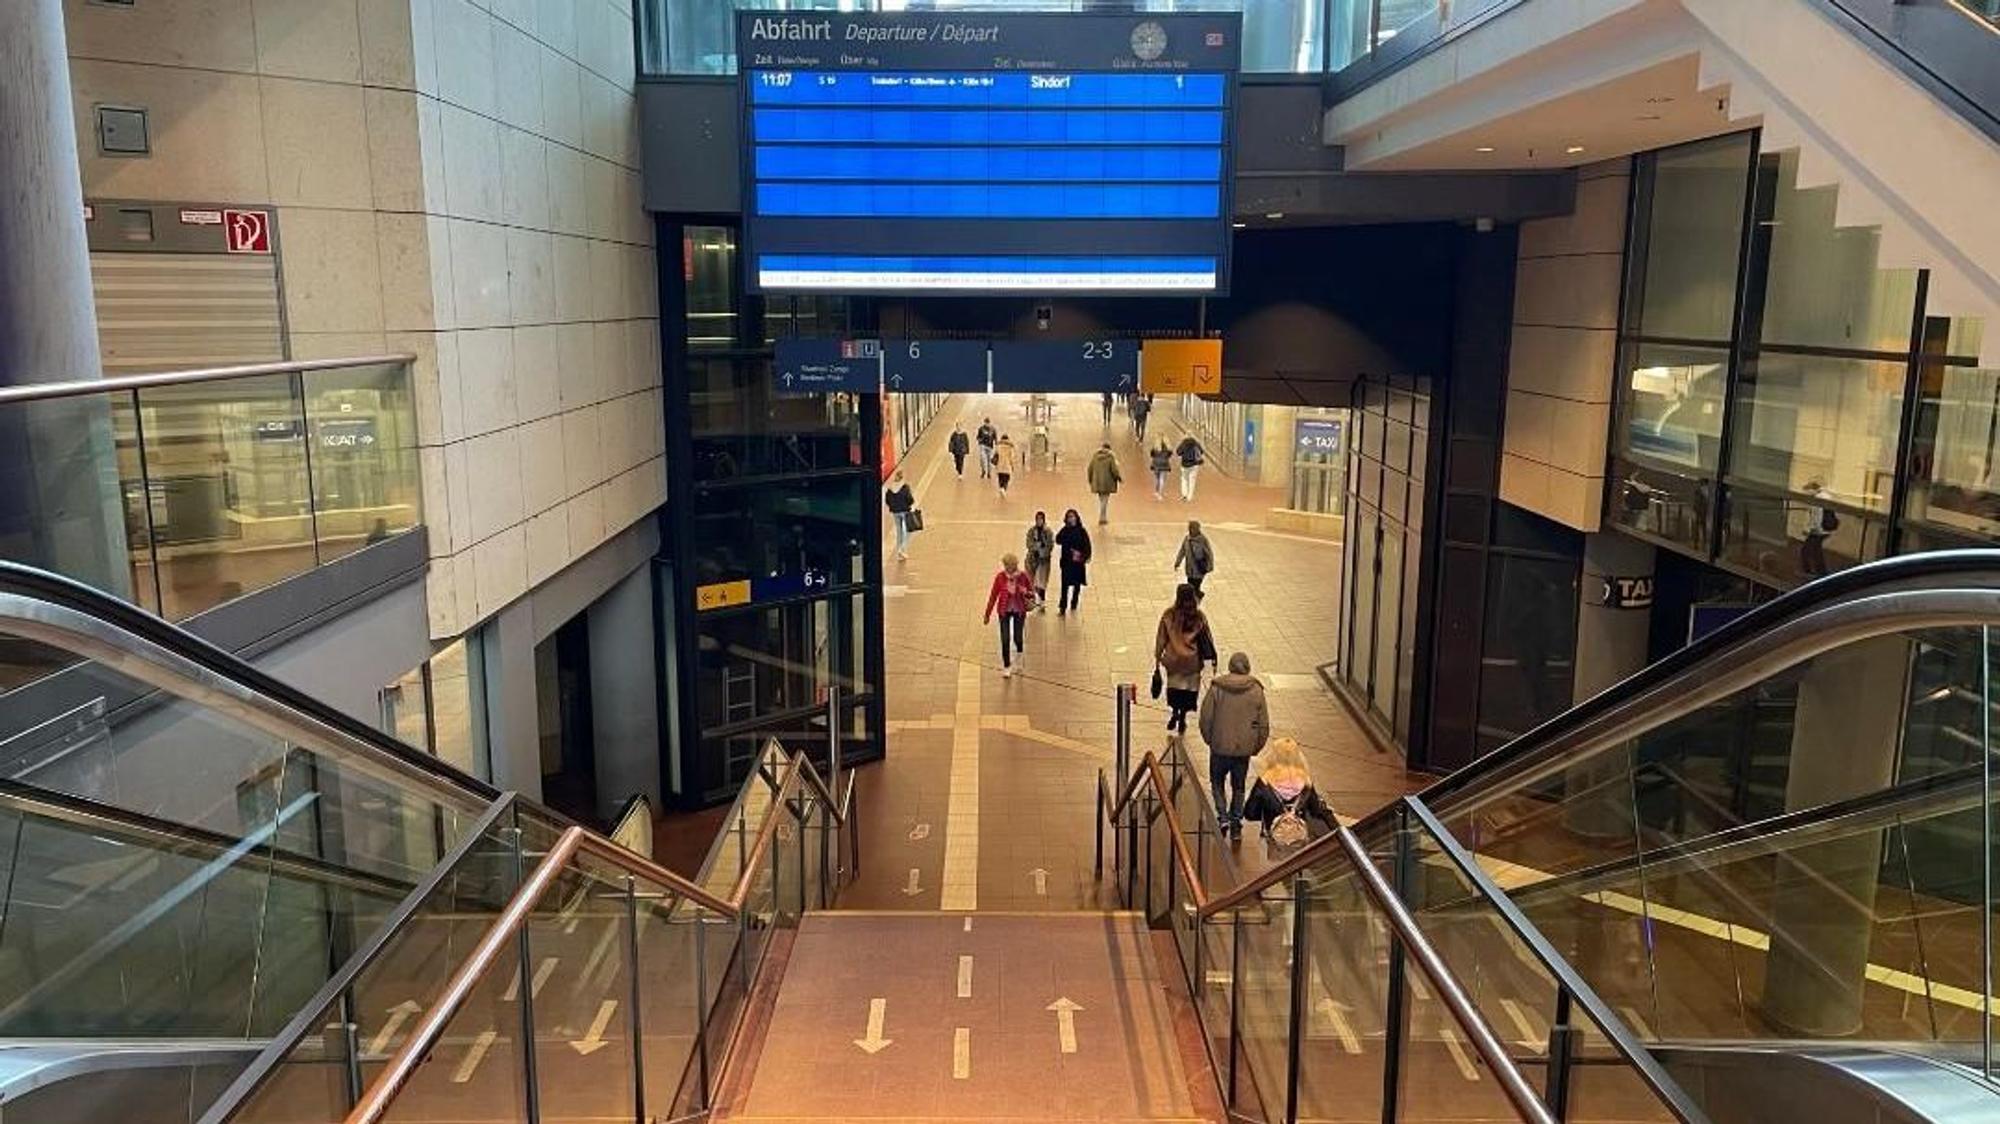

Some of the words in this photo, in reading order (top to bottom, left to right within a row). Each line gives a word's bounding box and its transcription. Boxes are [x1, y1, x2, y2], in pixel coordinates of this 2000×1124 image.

[752, 18, 832, 41] Abfahrt
[845, 23, 928, 46] Departure
[942, 24, 1000, 46] Départ
[761, 73, 792, 87] 11:07
[1030, 75, 1071, 88] Sindorf
[909, 342, 921, 359] 6
[1082, 342, 1114, 359] 2-3
[804, 572, 812, 585] 6
